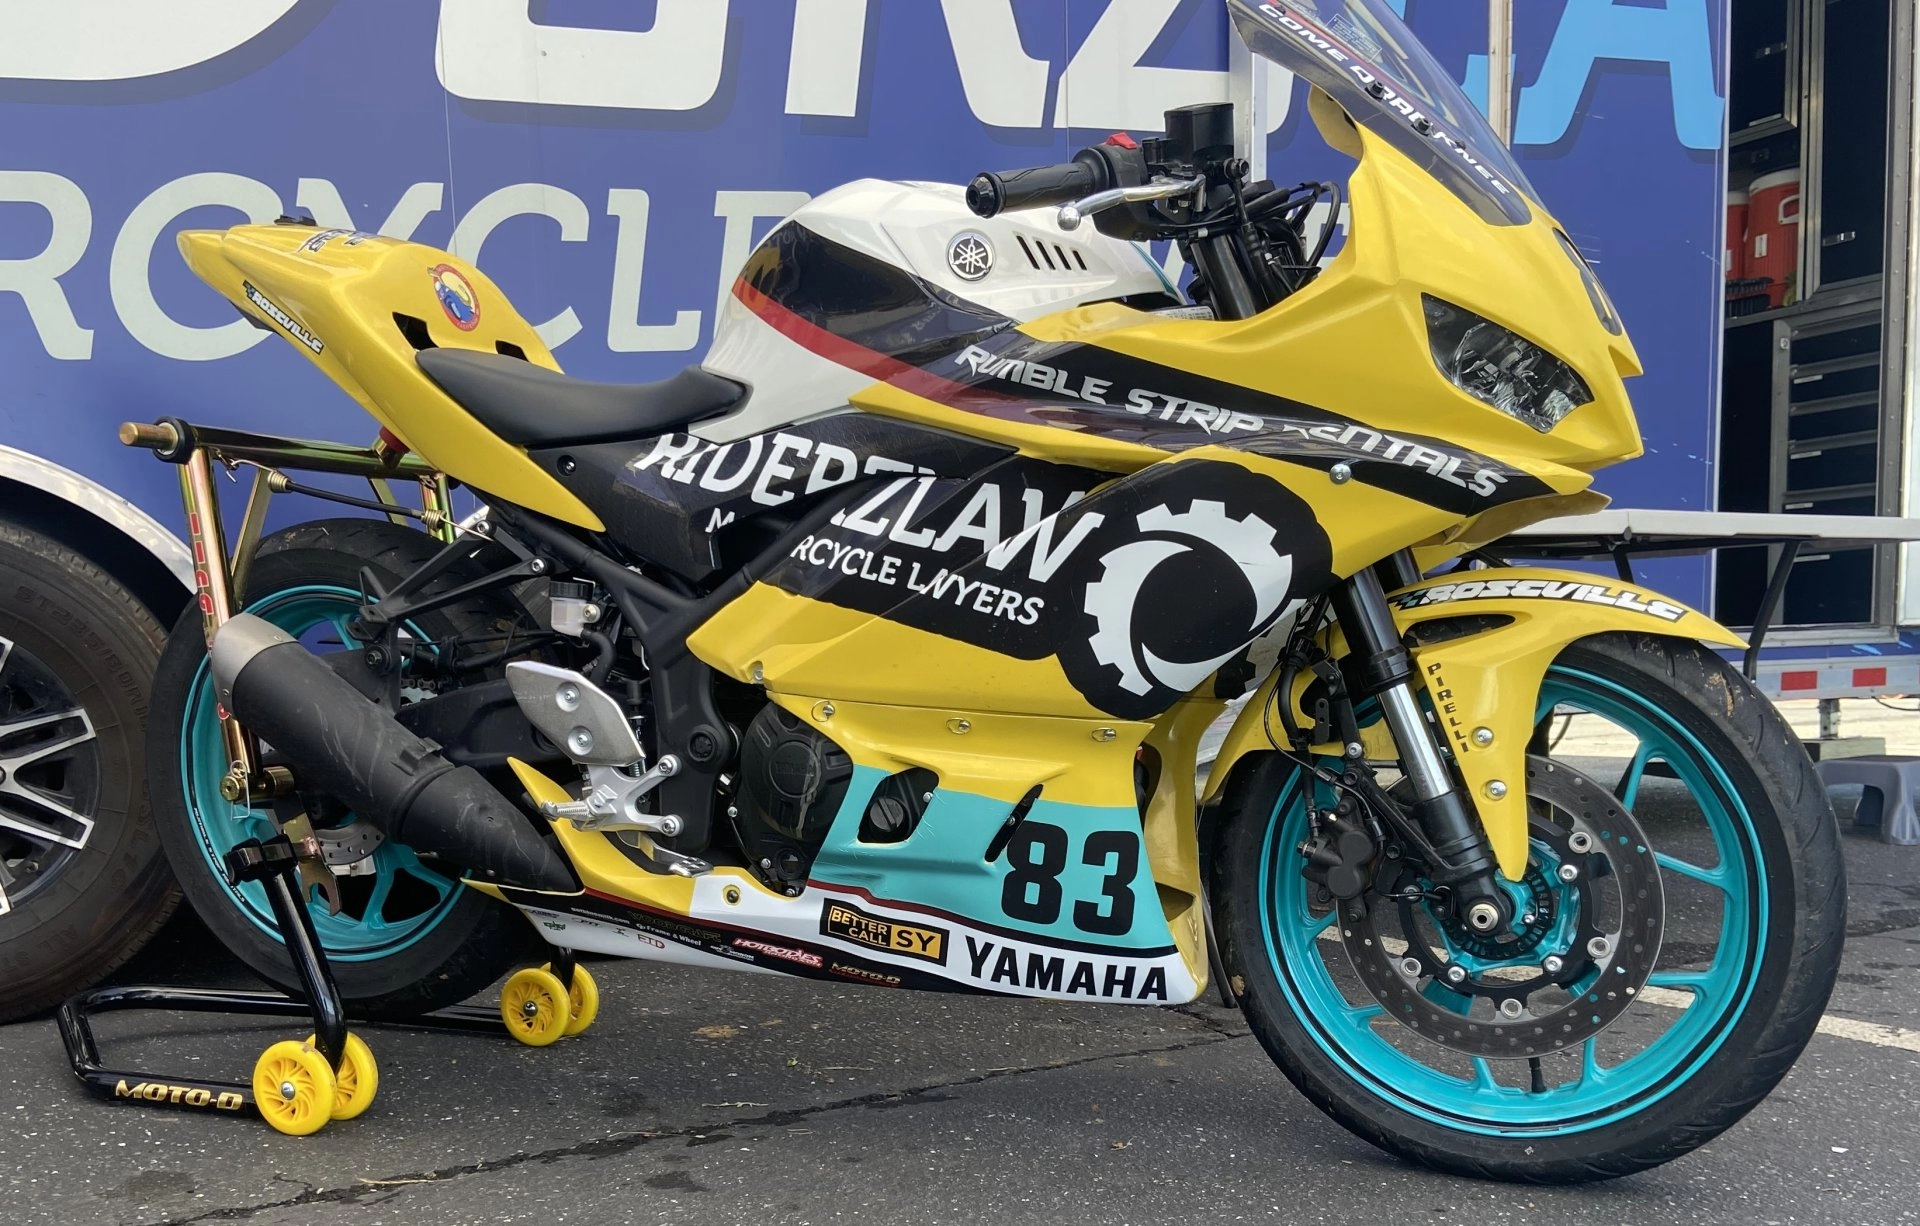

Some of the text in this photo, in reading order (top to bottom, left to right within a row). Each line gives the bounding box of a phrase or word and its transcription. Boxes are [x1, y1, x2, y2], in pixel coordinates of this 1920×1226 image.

[1258, 3, 1350, 63] COME
[1433, 131, 1512, 196] KNEE
[251, 289, 324, 354] ROSEVILLE
[954, 344, 1113, 405] RUMBLE
[1124, 388, 1265, 436] STRIP
[1419, 579, 1686, 621] ROSEVILLE
[1427, 662, 1469, 753] PIRELLI
[1001, 820, 1140, 936] 83
[679, 934, 702, 946] Wheel
[831, 909, 888, 936] BETTER
[848, 926, 887, 946] CALL
[896, 929, 936, 952] SY
[965, 935, 1168, 1001] YAMAHA
[115, 1079, 243, 1111] MOTO-D
